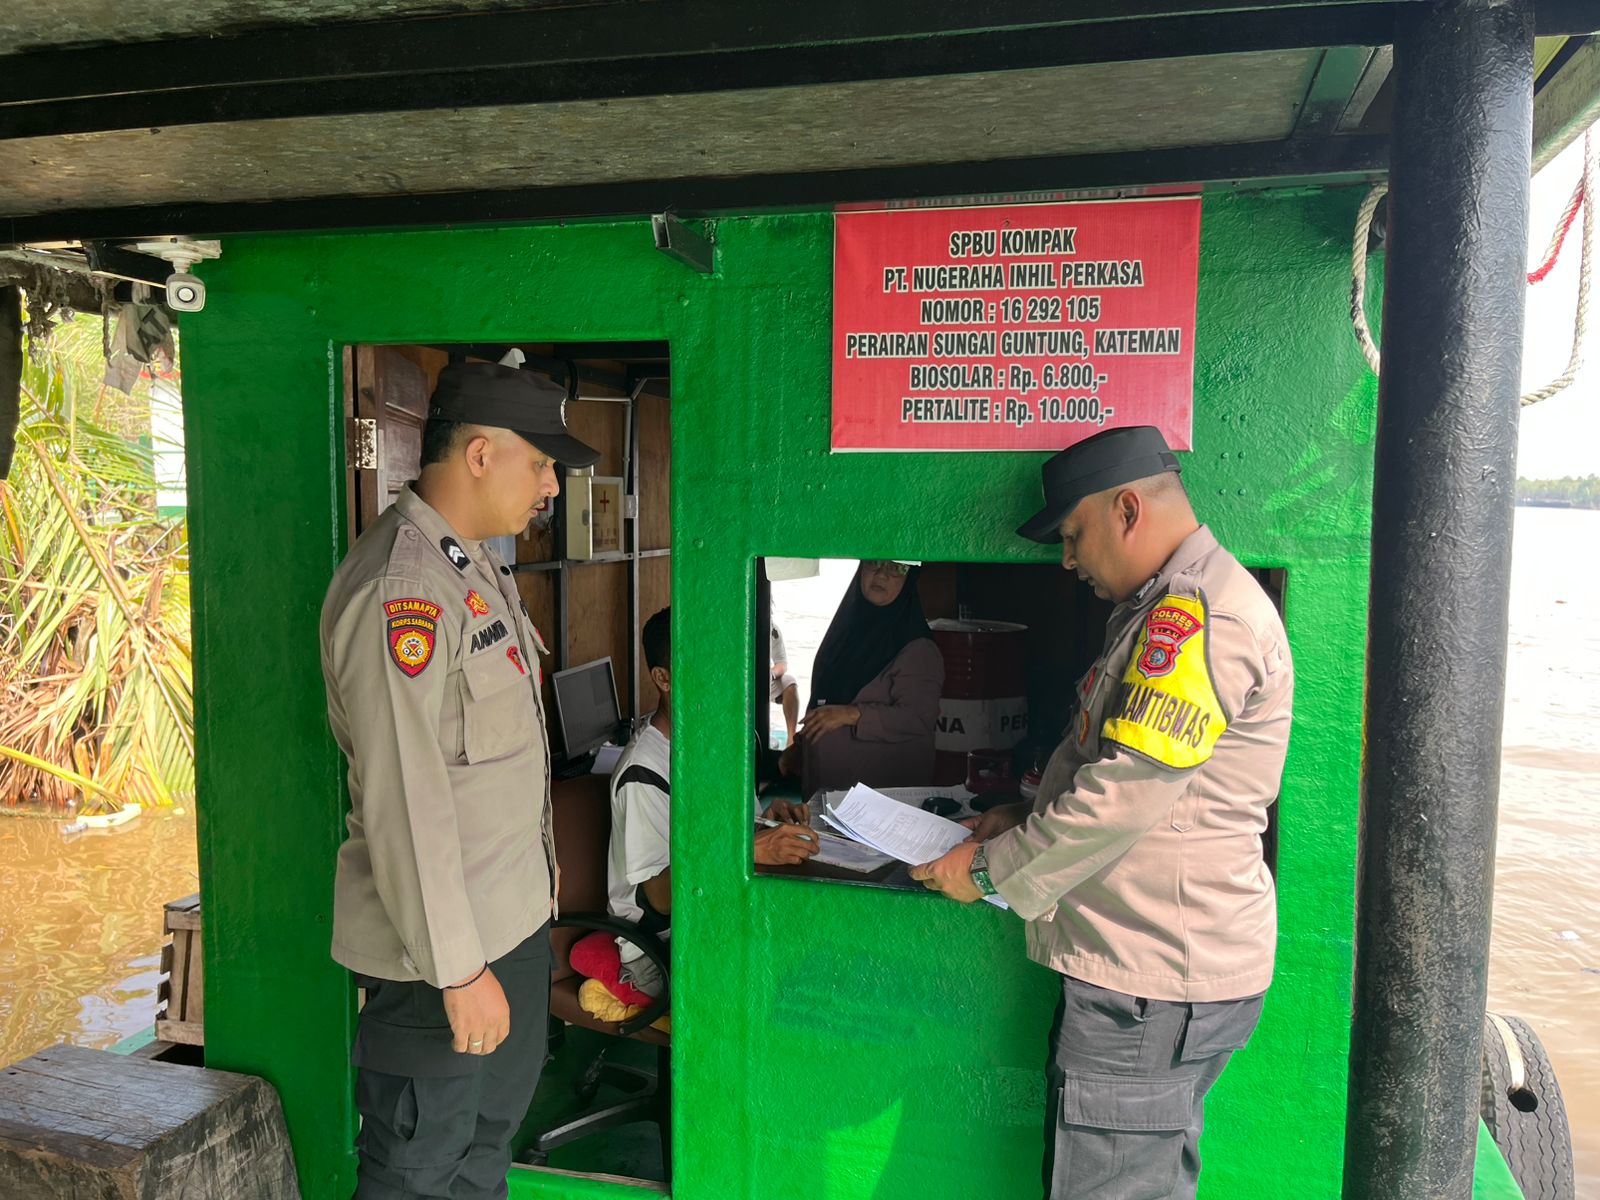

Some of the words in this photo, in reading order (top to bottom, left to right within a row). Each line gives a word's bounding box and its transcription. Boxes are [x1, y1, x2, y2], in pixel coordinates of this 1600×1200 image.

[949, 231, 996, 256] SPBU
[1001, 228, 1076, 254] KOMPAK
[884, 268, 908, 291] PT.
[914, 265, 1004, 290] NUGERAHA
[1009, 263, 1056, 288] INHIL
[1061, 261, 1143, 287] PERKASA
[921, 299, 984, 323] NOMOR
[1001, 298, 1022, 322] 16
[1027, 298, 1061, 321] 292
[1066, 297, 1100, 320] 105
[846, 334, 929, 357] PERAIRAN
[933, 332, 995, 356] SUNGAI
[1001, 331, 1089, 358] GUNTUNG,
[1094, 329, 1180, 353] KATEMAN
[910, 365, 993, 389] BIOSOLAR
[1010, 365, 1037, 392] Rp.
[1043, 364, 1106, 391] 6.800,-
[902, 398, 989, 421] PERTALITE
[1005, 398, 1032, 425] Rp.
[1039, 398, 1113, 424] 10.000,-
[1152, 610, 1193, 627] POLRES
